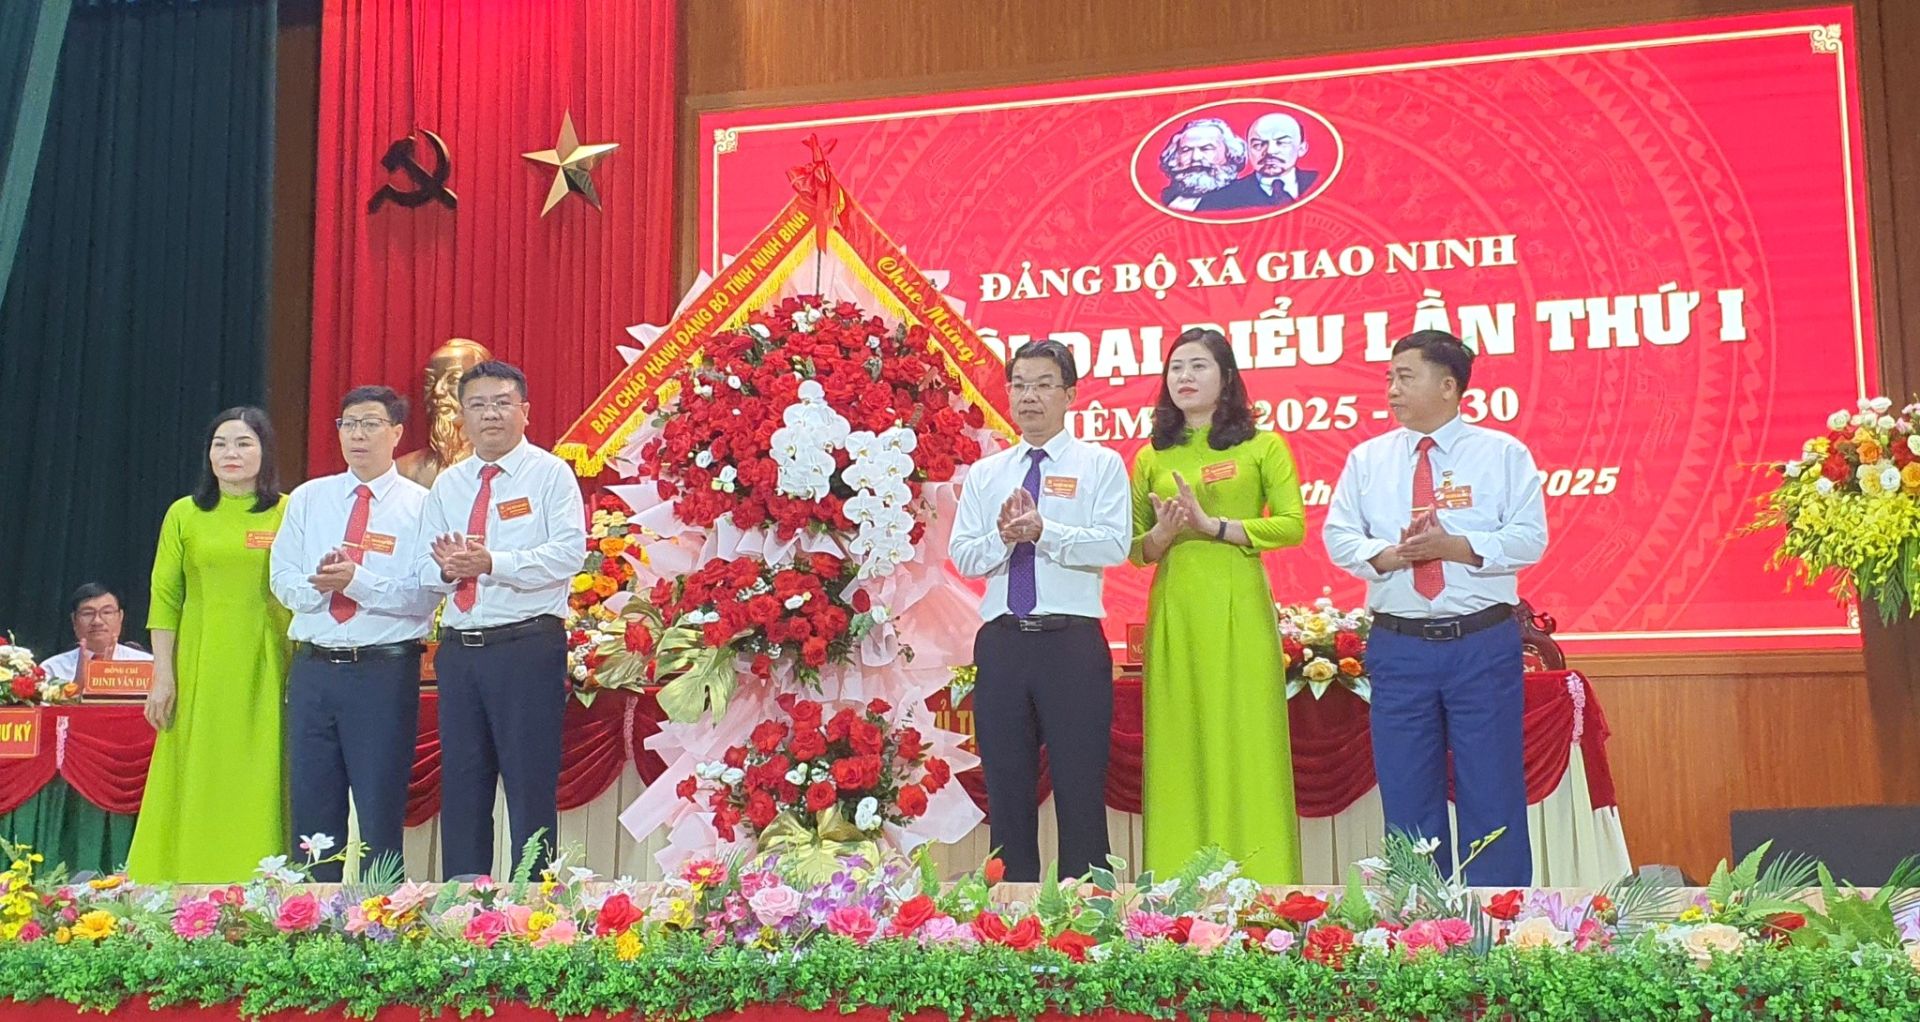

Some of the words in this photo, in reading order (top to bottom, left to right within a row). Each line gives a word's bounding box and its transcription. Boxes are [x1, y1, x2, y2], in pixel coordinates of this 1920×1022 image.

[877, 256, 923, 304] Chúc
[980, 261, 1103, 302] ĐẢNG
[1112, 252, 1178, 300] BỘ
[1187, 246, 1247, 288] XÃ
[1256, 244, 1375, 283] GIAO
[1385, 234, 1518, 274] NINH
[590, 398, 621, 435] BAN
[615, 369, 648, 409] CHẤP
[644, 342, 681, 378] HÀNH
[750, 236, 784, 271] NINH
[777, 211, 810, 243] BÌNH
[1181, 295, 1345, 371] IỂU
[1363, 287, 1516, 362] LẦN
[1536, 280, 1701, 352] THỨ
[1717, 288, 1747, 342] I
[1254, 395, 1359, 433] 2025
[0, 721, 13, 742] Ư
[13, 719, 32, 742] KÝ
